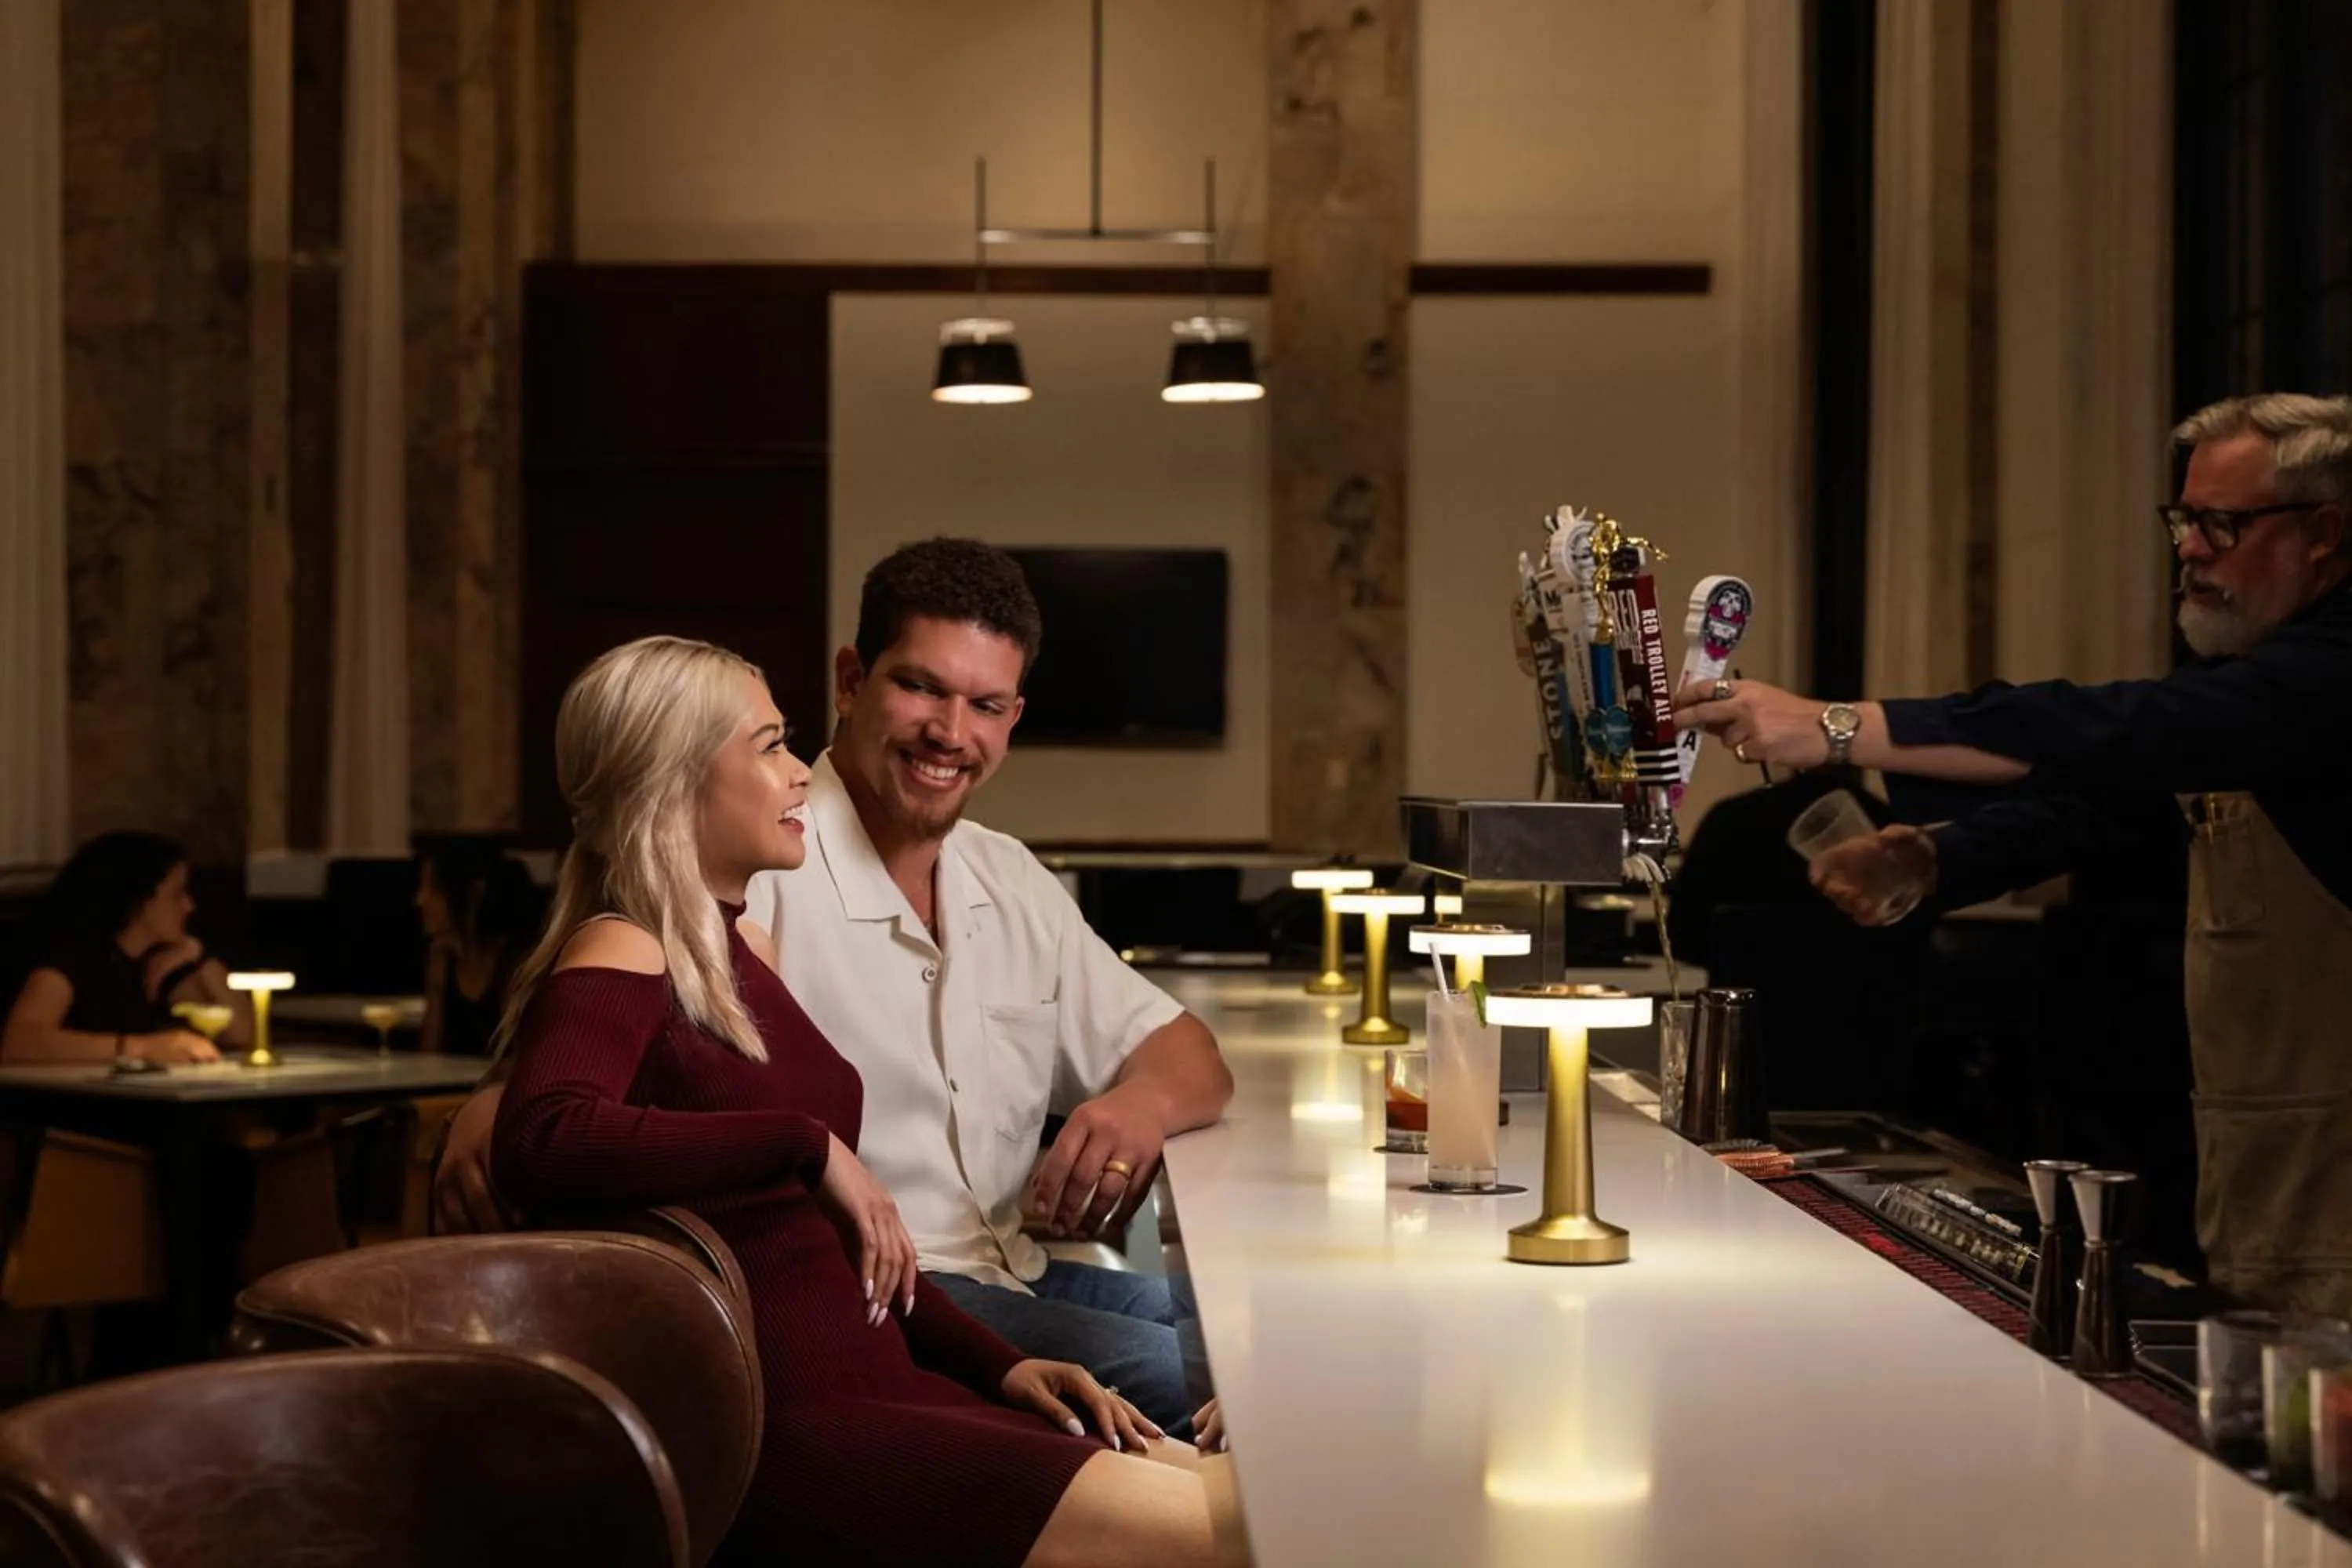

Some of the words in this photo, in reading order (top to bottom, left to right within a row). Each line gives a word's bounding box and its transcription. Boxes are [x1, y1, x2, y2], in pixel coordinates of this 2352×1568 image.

[1641, 608, 1660, 633] RED
[1646, 638, 1668, 694] TROLLEY
[1532, 637, 1564, 740] STONE
[1653, 699, 1671, 723] ALE
